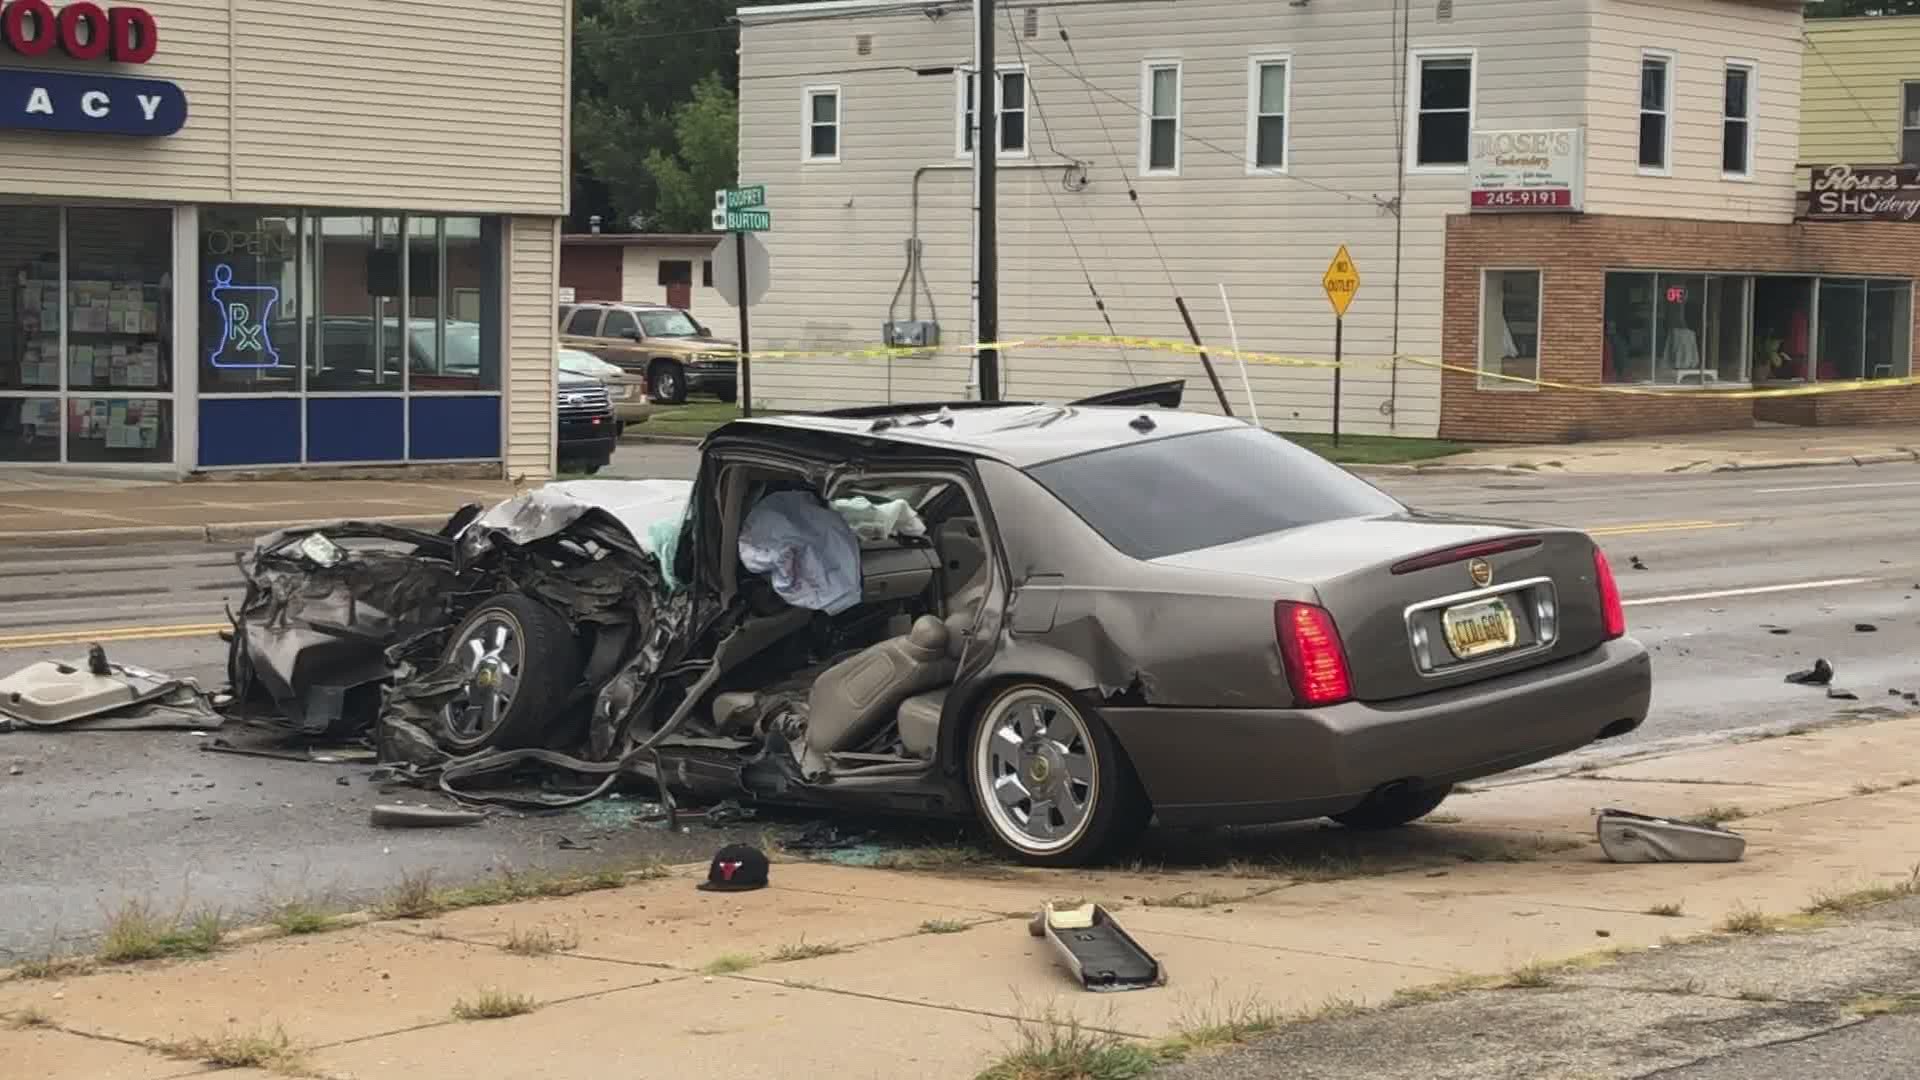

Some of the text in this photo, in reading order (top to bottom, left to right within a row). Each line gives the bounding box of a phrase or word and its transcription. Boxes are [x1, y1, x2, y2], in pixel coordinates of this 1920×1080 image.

[0, 0, 157, 64] OOD
[1487, 191, 1557, 205] 245-9191
[728, 212, 769, 229] BURTON
[207, 229, 286, 255] OPEN
[1337, 261, 1348, 272] NO
[1328, 279, 1355, 292] OUTLET
